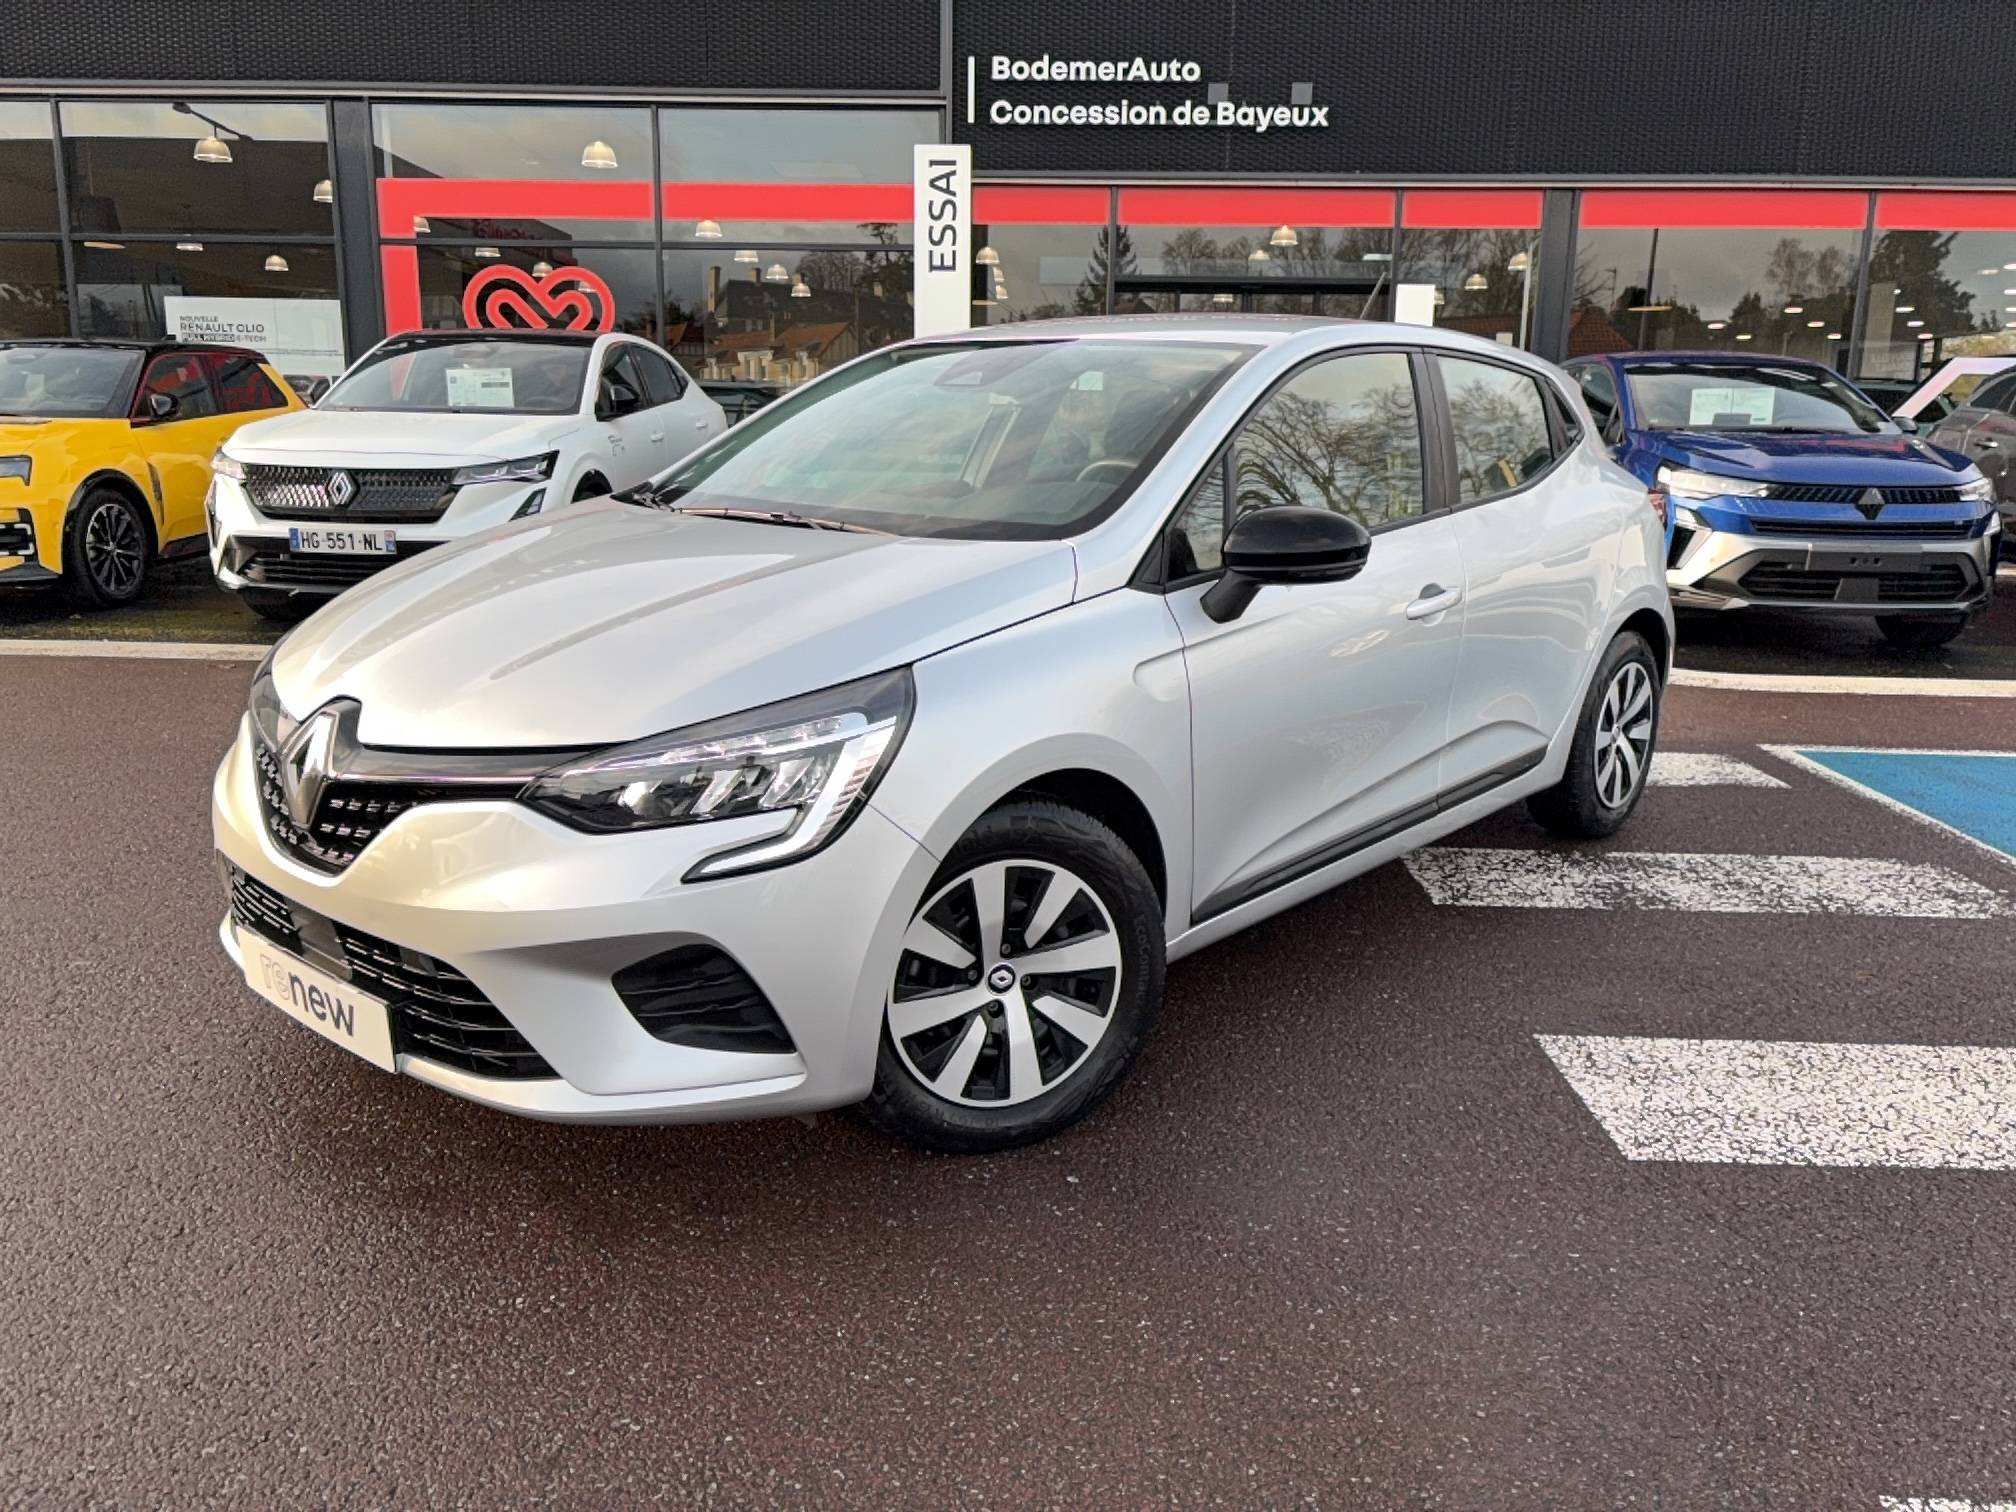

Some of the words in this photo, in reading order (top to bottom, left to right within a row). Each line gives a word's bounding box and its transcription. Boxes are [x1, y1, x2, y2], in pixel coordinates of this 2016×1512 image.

[991, 54, 1201, 82] BodemerAuto
[990, 100, 1168, 126] Concession
[1173, 100, 1210, 126] de
[1216, 101, 1329, 133] Bayeux
[928, 159, 957, 272] ESSAI
[180, 323, 233, 333] RENAULT
[260, 953, 354, 1037] renew
